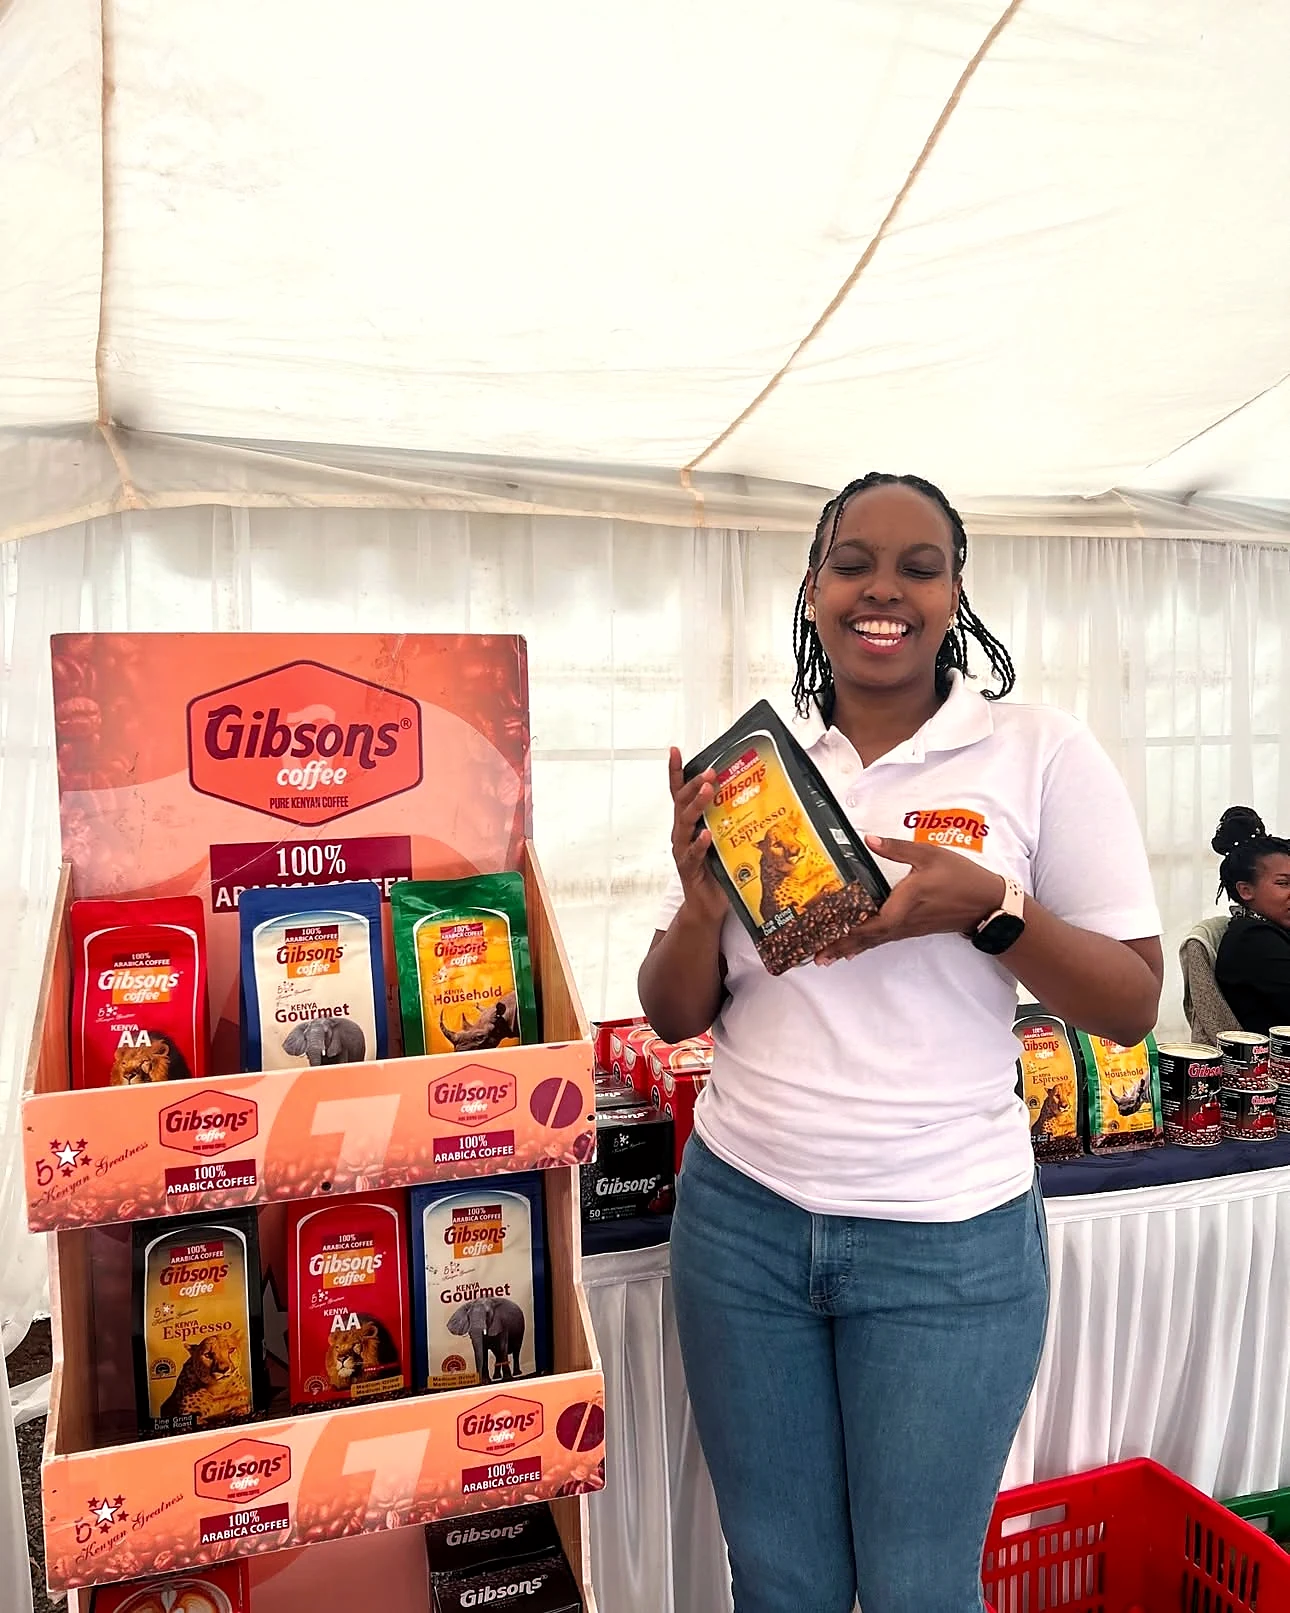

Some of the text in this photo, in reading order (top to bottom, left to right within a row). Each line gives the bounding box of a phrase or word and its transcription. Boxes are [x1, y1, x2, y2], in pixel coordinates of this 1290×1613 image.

[277, 760, 347, 790] coffee
[714, 764, 766, 806] Gibsons
[269, 796, 348, 809] PURE KENYAN COFFEE
[729, 807, 786, 848] Espresso
[904, 811, 990, 838] Gibsons
[928, 828, 972, 845] coffee
[277, 845, 346, 876] 100%
[285, 935, 313, 943] ARABICA
[132, 952, 151, 960] 100%
[277, 945, 343, 964] Gibsons
[434, 941, 488, 957] Gibsons
[451, 954, 478, 965] coffee
[297, 961, 330, 975] coffee
[98, 970, 179, 992] Gibsons
[123, 990, 159, 1003] coffee
[434, 986, 502, 1005] Household
[275, 1004, 349, 1023] Gourmet
[291, 1002, 317, 1011] KENYA
[118, 1030, 151, 1048] AA
[1024, 1040, 1059, 1051] Gibsons
[1033, 1075, 1068, 1086] Espresso
[1105, 1067, 1144, 1078] Household
[434, 1083, 508, 1104] Gibsons
[460, 1101, 488, 1114] coffee
[166, 1110, 248, 1133] Gibsons
[195, 1129, 226, 1143] coffee
[459, 1135, 488, 1150] 100%
[435, 1145, 513, 1163] ARABICA COFFEE
[32, 1142, 148, 1209] Kenyan Greatness
[194, 1165, 226, 1180] 100%
[167, 1175, 255, 1195] ARABICA COFFEE
[452, 1213, 501, 1223] ARABICA COFFEE
[468, 1207, 486, 1216] 100%
[590, 1209, 600, 1217] 50
[339, 1234, 356, 1243] 100%
[444, 1225, 507, 1245] Gibsons
[187, 1244, 206, 1255] 100%
[323, 1240, 374, 1251] ARABICA COFFEE
[463, 1241, 493, 1257] coffee
[171, 1250, 224, 1264] ARABICA COFFEE
[309, 1253, 383, 1276] Gibsons
[160, 1263, 229, 1286] Gibsons
[333, 1271, 366, 1286] coffee
[179, 1282, 214, 1297] coffee
[441, 1283, 511, 1304] Gourmet
[456, 1282, 480, 1292] KENYA
[323, 1307, 349, 1316] KENYA
[162, 1320, 232, 1341] Espresso
[175, 1319, 199, 1329] KENYA
[331, 1312, 361, 1333] AA
[173, 1415, 193, 1424] Grind
[173, 1421, 192, 1429] Roast
[463, 1412, 535, 1436] Gibsons
[488, 1429, 516, 1443] coffee
[201, 1457, 282, 1483] Gibsons
[487, 1462, 515, 1479] 100%
[229, 1476, 260, 1491] coffee
[463, 1471, 540, 1493] ARABICA COFFEE
[229, 1509, 260, 1528] 100%
[75, 1493, 184, 1563] Kenyan Greatness
[202, 1518, 289, 1543] ARABICA COFFEE
